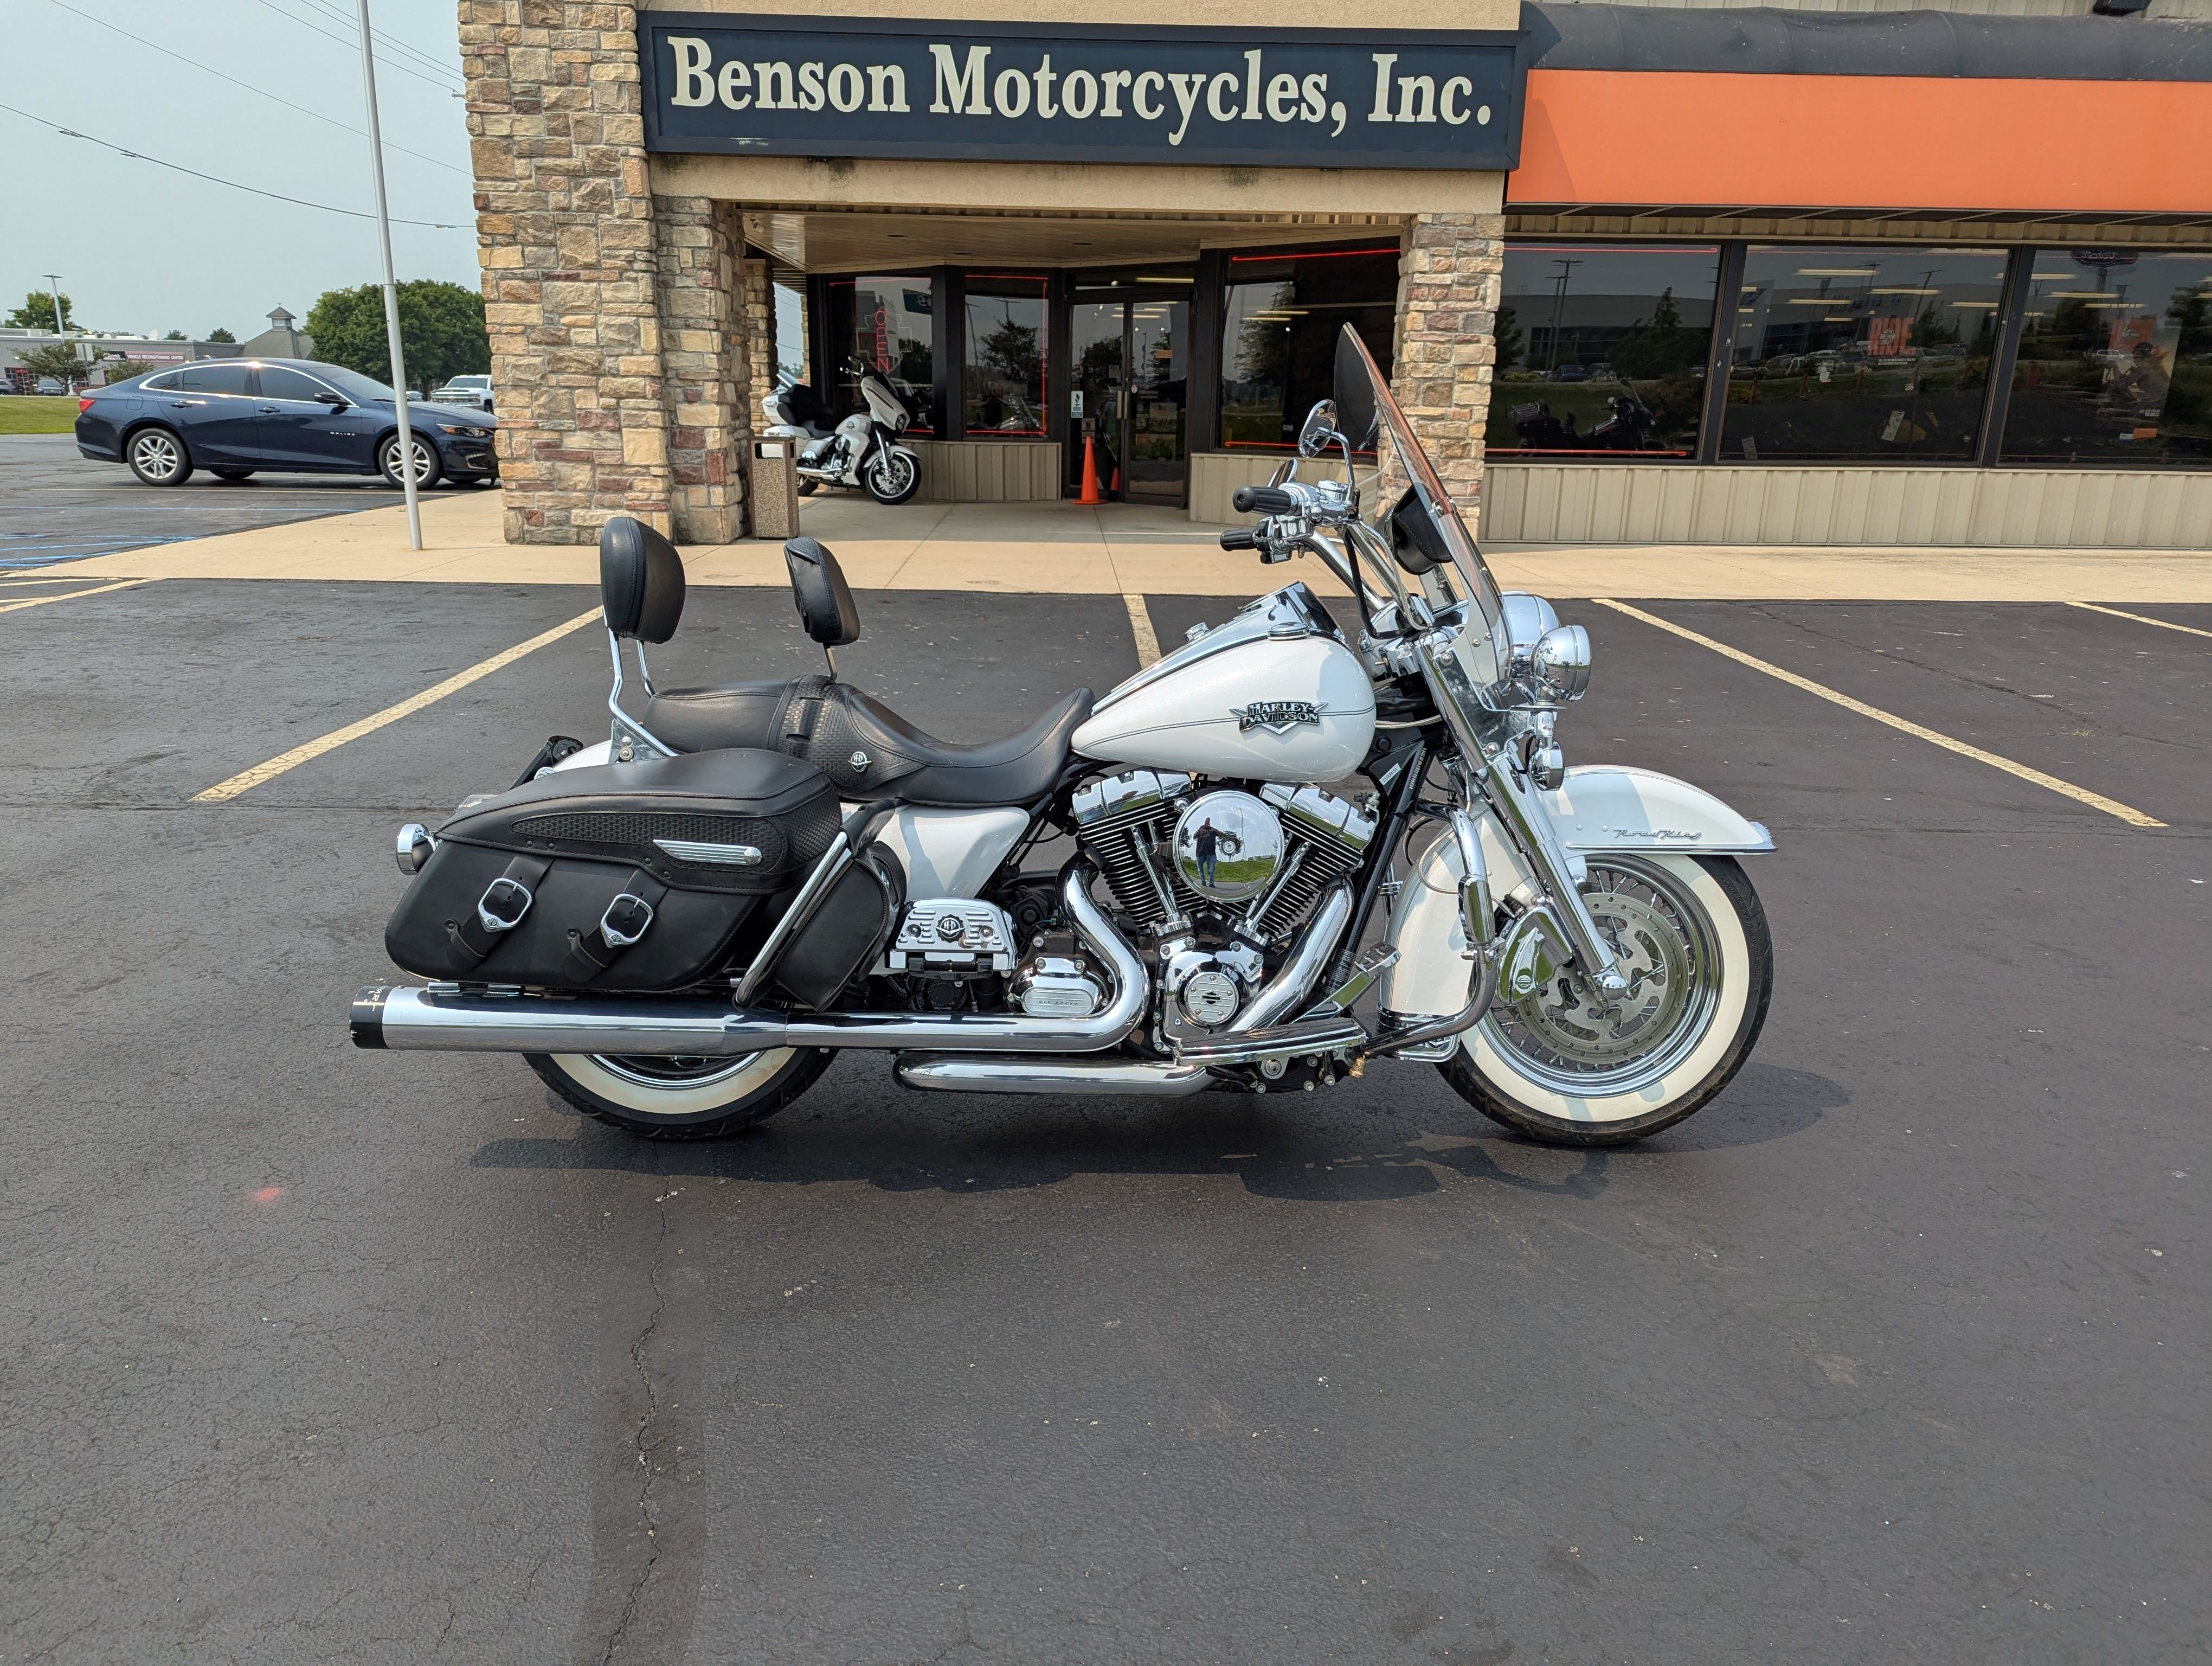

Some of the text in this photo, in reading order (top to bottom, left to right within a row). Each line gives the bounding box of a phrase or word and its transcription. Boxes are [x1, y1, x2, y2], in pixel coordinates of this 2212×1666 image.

[667, 36, 1491, 146] Benson Motorcycles, Inc.
[876, 310, 890, 373] OPEN
[1241, 712, 1318, 728] DAVIDSON
[943, 920, 956, 930] H-D
